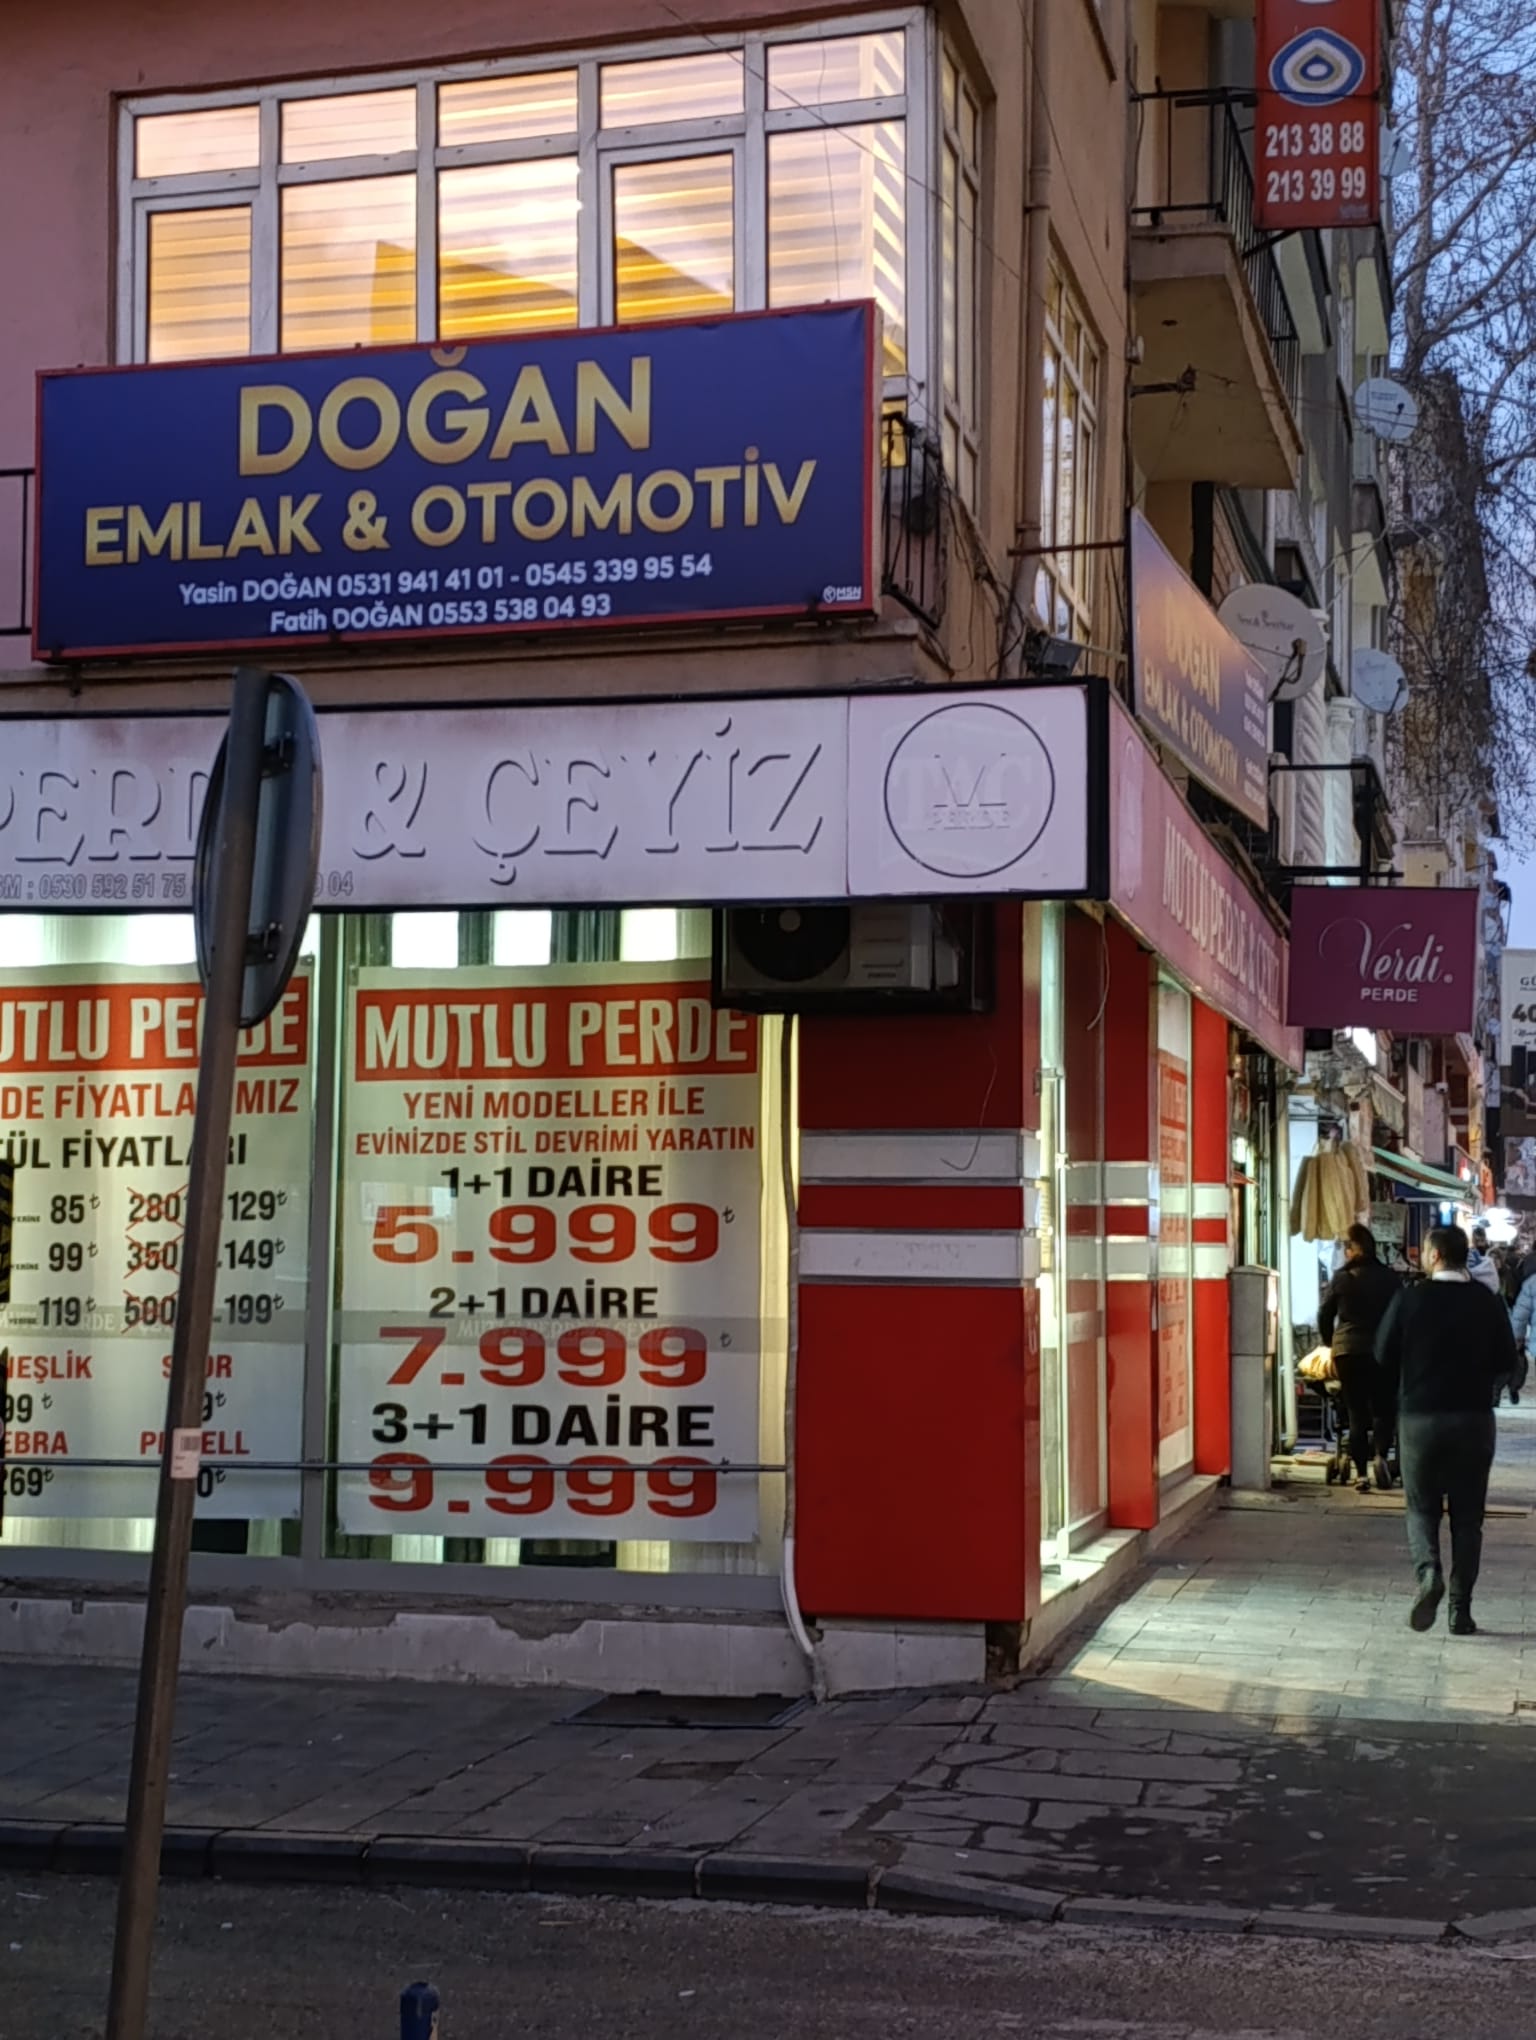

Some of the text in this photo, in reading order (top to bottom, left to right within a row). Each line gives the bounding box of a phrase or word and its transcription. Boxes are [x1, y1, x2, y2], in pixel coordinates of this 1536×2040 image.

[1265, 121, 1365, 157] 213 38 88
[1266, 166, 1366, 203] 213 39 99
[239, 346, 651, 477] DOĞAN
[85, 446, 817, 566] EMLAK & OTOMOTİV
[179, 581, 237, 605] Yasin
[242, 572, 332, 602] DOĞAN
[337, 572, 392, 596] 0531
[397, 569, 439, 594] 941
[444, 567, 471, 591] 41
[477, 566, 504, 589] 01
[525, 562, 587, 587] 0545
[593, 558, 637, 583] 339
[644, 556, 674, 580] 95
[680, 553, 712, 577] 54
[269, 593, 611, 633] Fatih DOĞAN 0553 538 04 93
[352, 760, 427, 859] &
[473, 715, 823, 886] ÇEYİZ
[39, 874, 87, 899] 0530
[91, 874, 128, 899] 592
[132, 873, 155, 898] 51
[162, 873, 186, 898] 75
[327, 871, 354, 897] 04
[1360, 987, 1418, 1002] PERDE
[364, 998, 748, 1070] MUTLU PERDE
[54, 1076, 300, 1118] FİYATLAMIZ
[403, 1081, 705, 1119] YENİ MODELLER İLE
[356, 1123, 755, 1155] EVİNİZDE STİL DEVRİMİ YARATIN
[441, 1156, 663, 1198] 1+1 DAİRE
[429, 1279, 658, 1319] 2+1 DAİRE
[371, 1394, 715, 1447] 3+1 DAİRE
